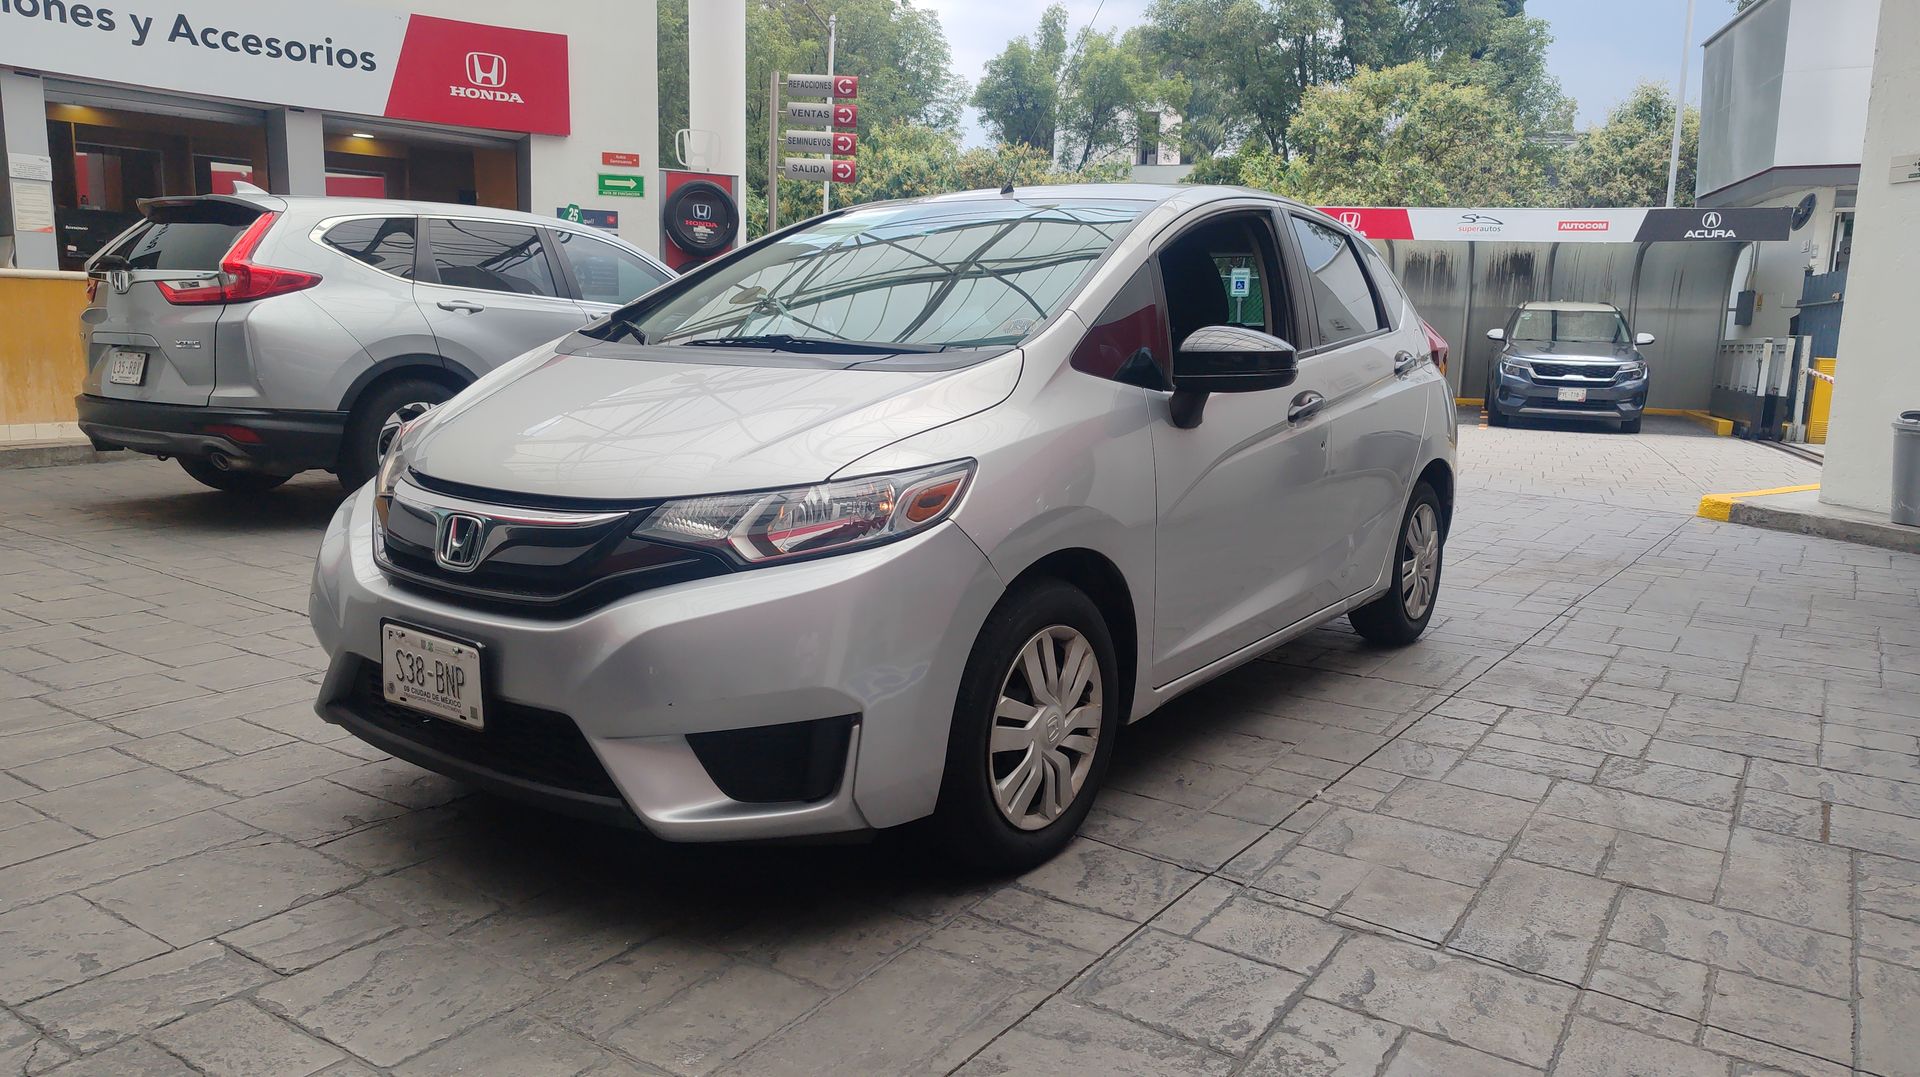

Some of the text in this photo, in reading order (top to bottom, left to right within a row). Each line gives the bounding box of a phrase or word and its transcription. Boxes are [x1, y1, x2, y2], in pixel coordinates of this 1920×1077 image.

[129, 13, 153, 46] y
[167, 13, 377, 72] Accesorios
[788, 79, 832, 90] REFACCIONES
[449, 85, 525, 104] HONDA
[791, 108, 830, 119] VENTAS
[787, 136, 832, 147] SEMINUEVOS
[791, 164, 826, 174] SALIDA
[567, 207, 579, 222] 25
[685, 219, 719, 228] HONDA
[1456, 224, 1501, 233] superautos
[1560, 222, 1607, 231] AUTOCOM
[1683, 229, 1737, 239] ACURA
[395, 648, 465, 700] S38-BNP
[411, 687, 431, 698] CIUDAD
[431, 693, 440, 702] DE
